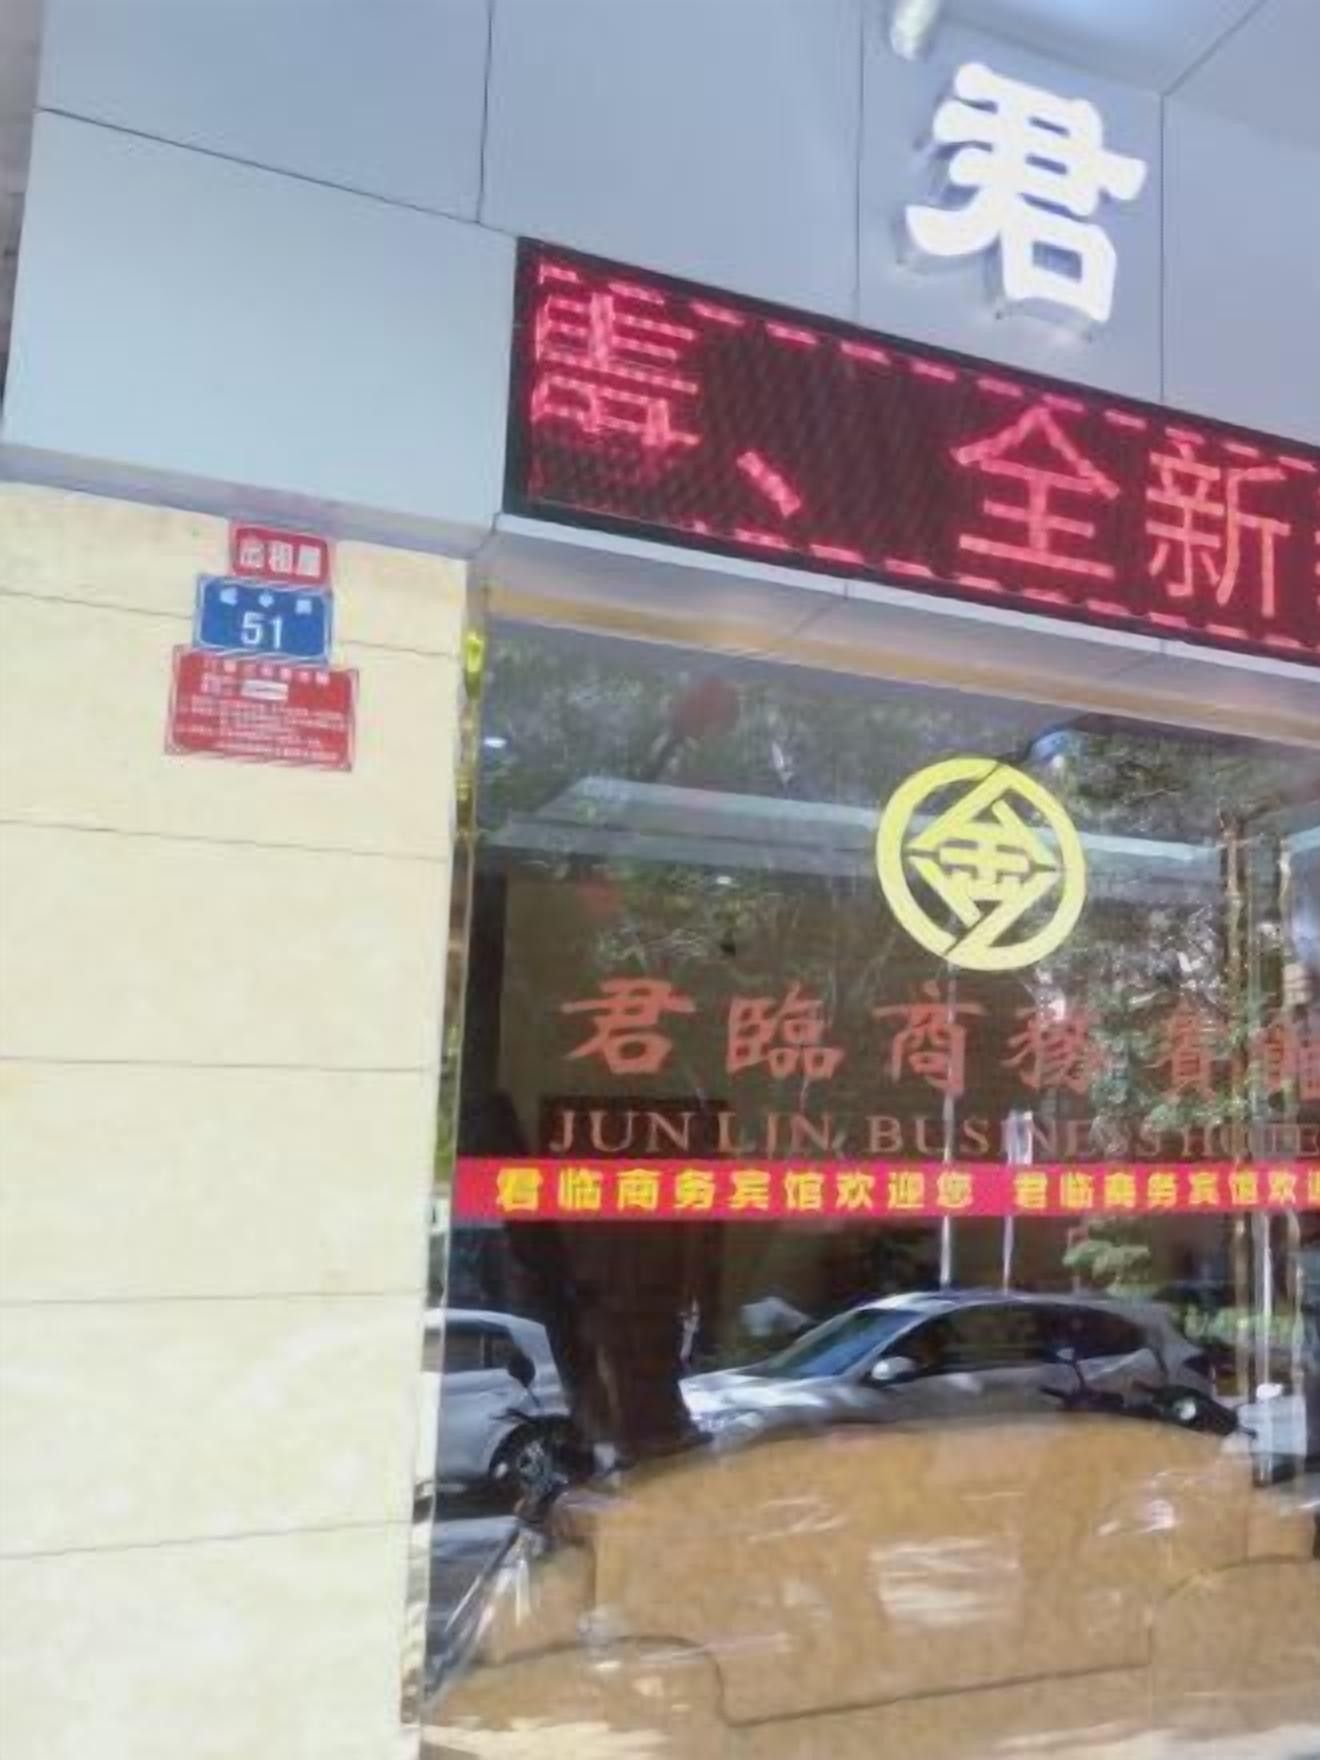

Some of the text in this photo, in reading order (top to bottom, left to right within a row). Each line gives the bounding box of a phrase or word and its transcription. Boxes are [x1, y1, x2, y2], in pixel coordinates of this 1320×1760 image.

[241, 610, 283, 649] 51
[549, 1110, 695, 1154] JUN
[496, 1167, 976, 1212] 君临商务宾馆欢迎您
